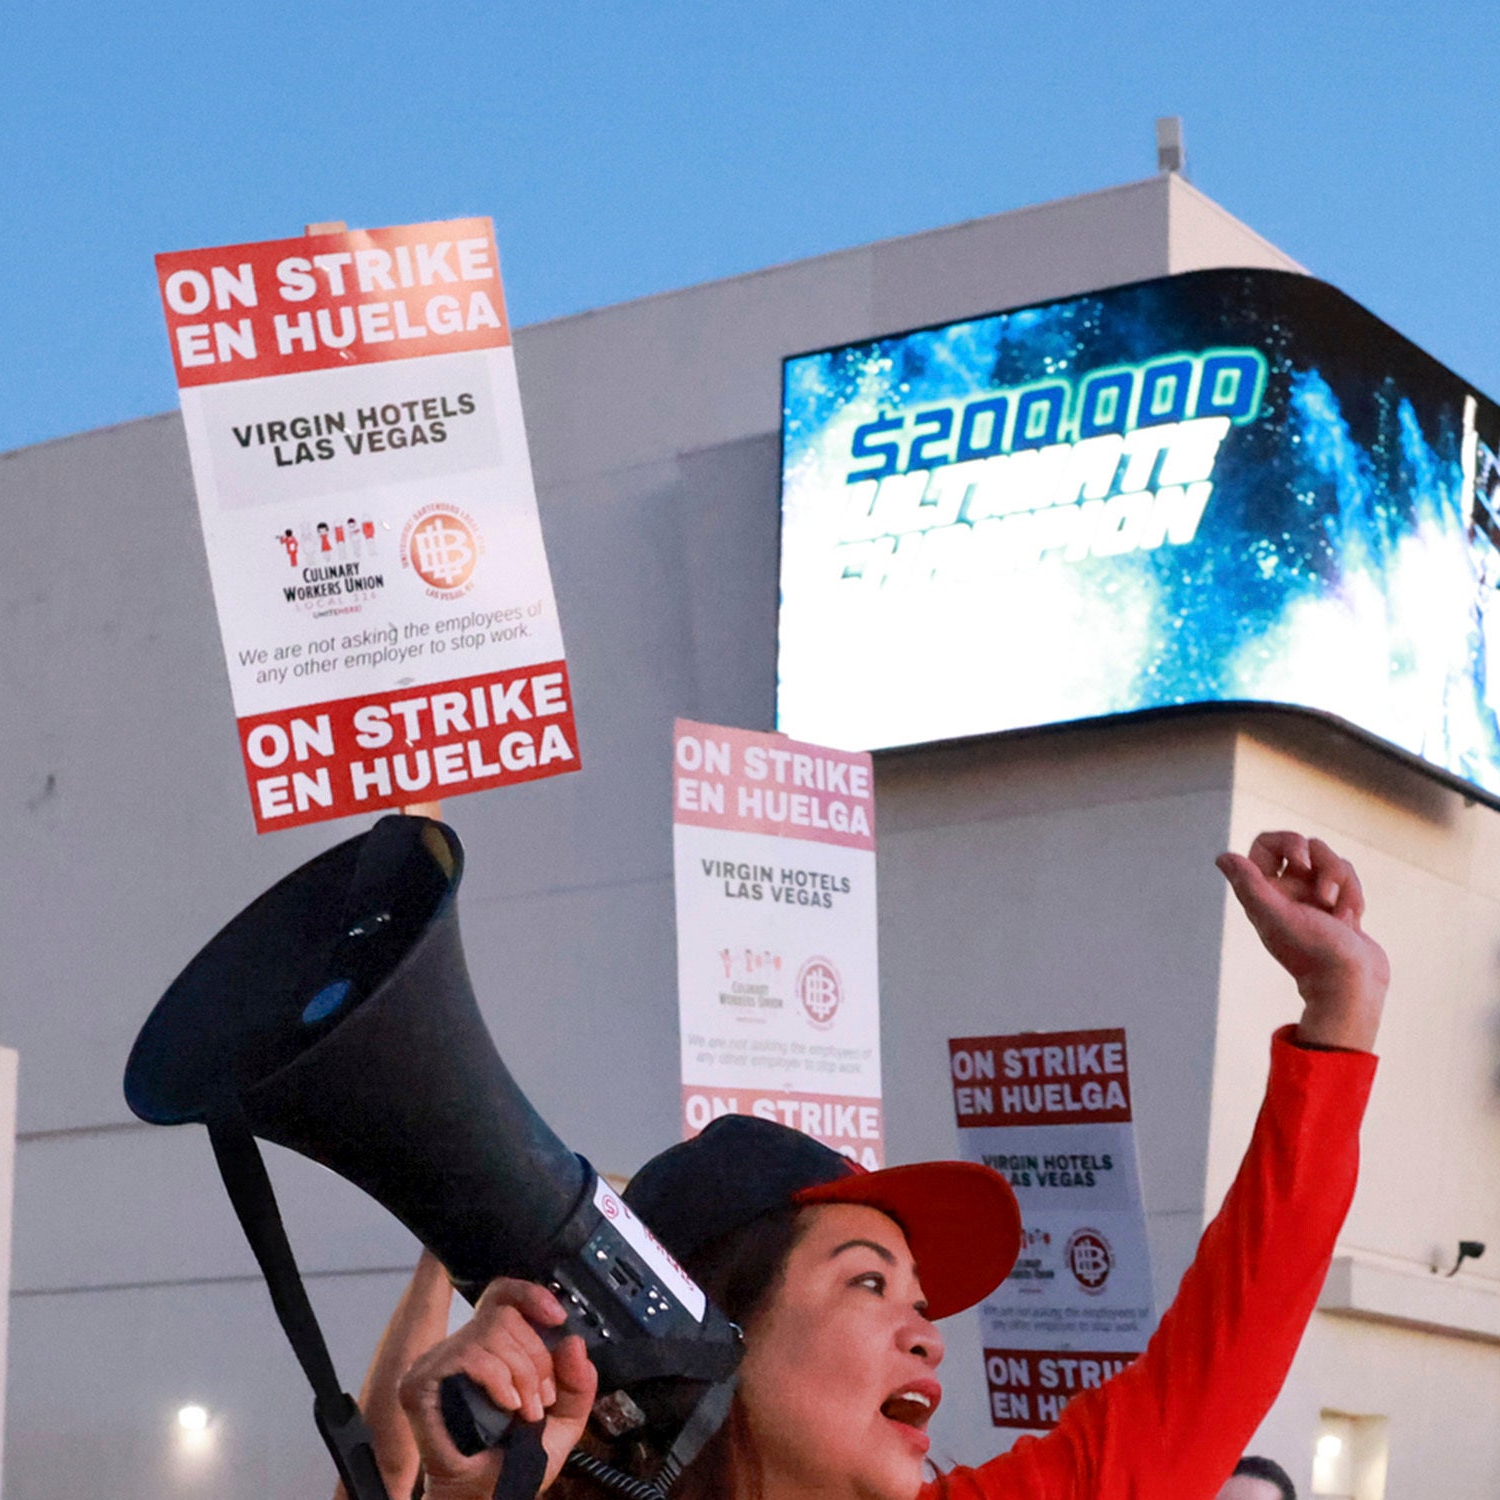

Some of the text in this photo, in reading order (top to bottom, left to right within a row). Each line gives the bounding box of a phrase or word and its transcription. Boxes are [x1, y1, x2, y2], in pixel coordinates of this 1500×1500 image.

[165, 237, 494, 316] ON STRIKE
[175, 290, 502, 368] EN HUELGA
[232, 393, 476, 449] VIRGIN HOTELS
[273, 421, 448, 468] LAS VEGAS
[238, 600, 543, 666] We are not asking the employees of
[256, 667, 288, 684] any
[293, 656, 338, 677] other
[344, 643, 424, 668] employer
[430, 639, 446, 654] to
[451, 632, 485, 650] stop
[246, 673, 568, 768] ON STRIKE
[256, 724, 575, 819] EN HUELGA
[676, 736, 870, 799] ON STRIKE
[677, 777, 871, 837] EN HUELGA
[701, 858, 851, 894] VIRGIN HOTELS
[724, 881, 833, 909] LAS VEGAS
[953, 1043, 1124, 1081] ON STRIKE
[752, 1098, 880, 1140] STRIKE
[956, 1081, 1127, 1115] EN HUELGA
[982, 1154, 1114, 1171] VIRGIN HOTELS
[1002, 1171, 1096, 1187] AS VEGAS
[987, 1356, 1134, 1389] ON STRI
[993, 1392, 1030, 1420] EN
